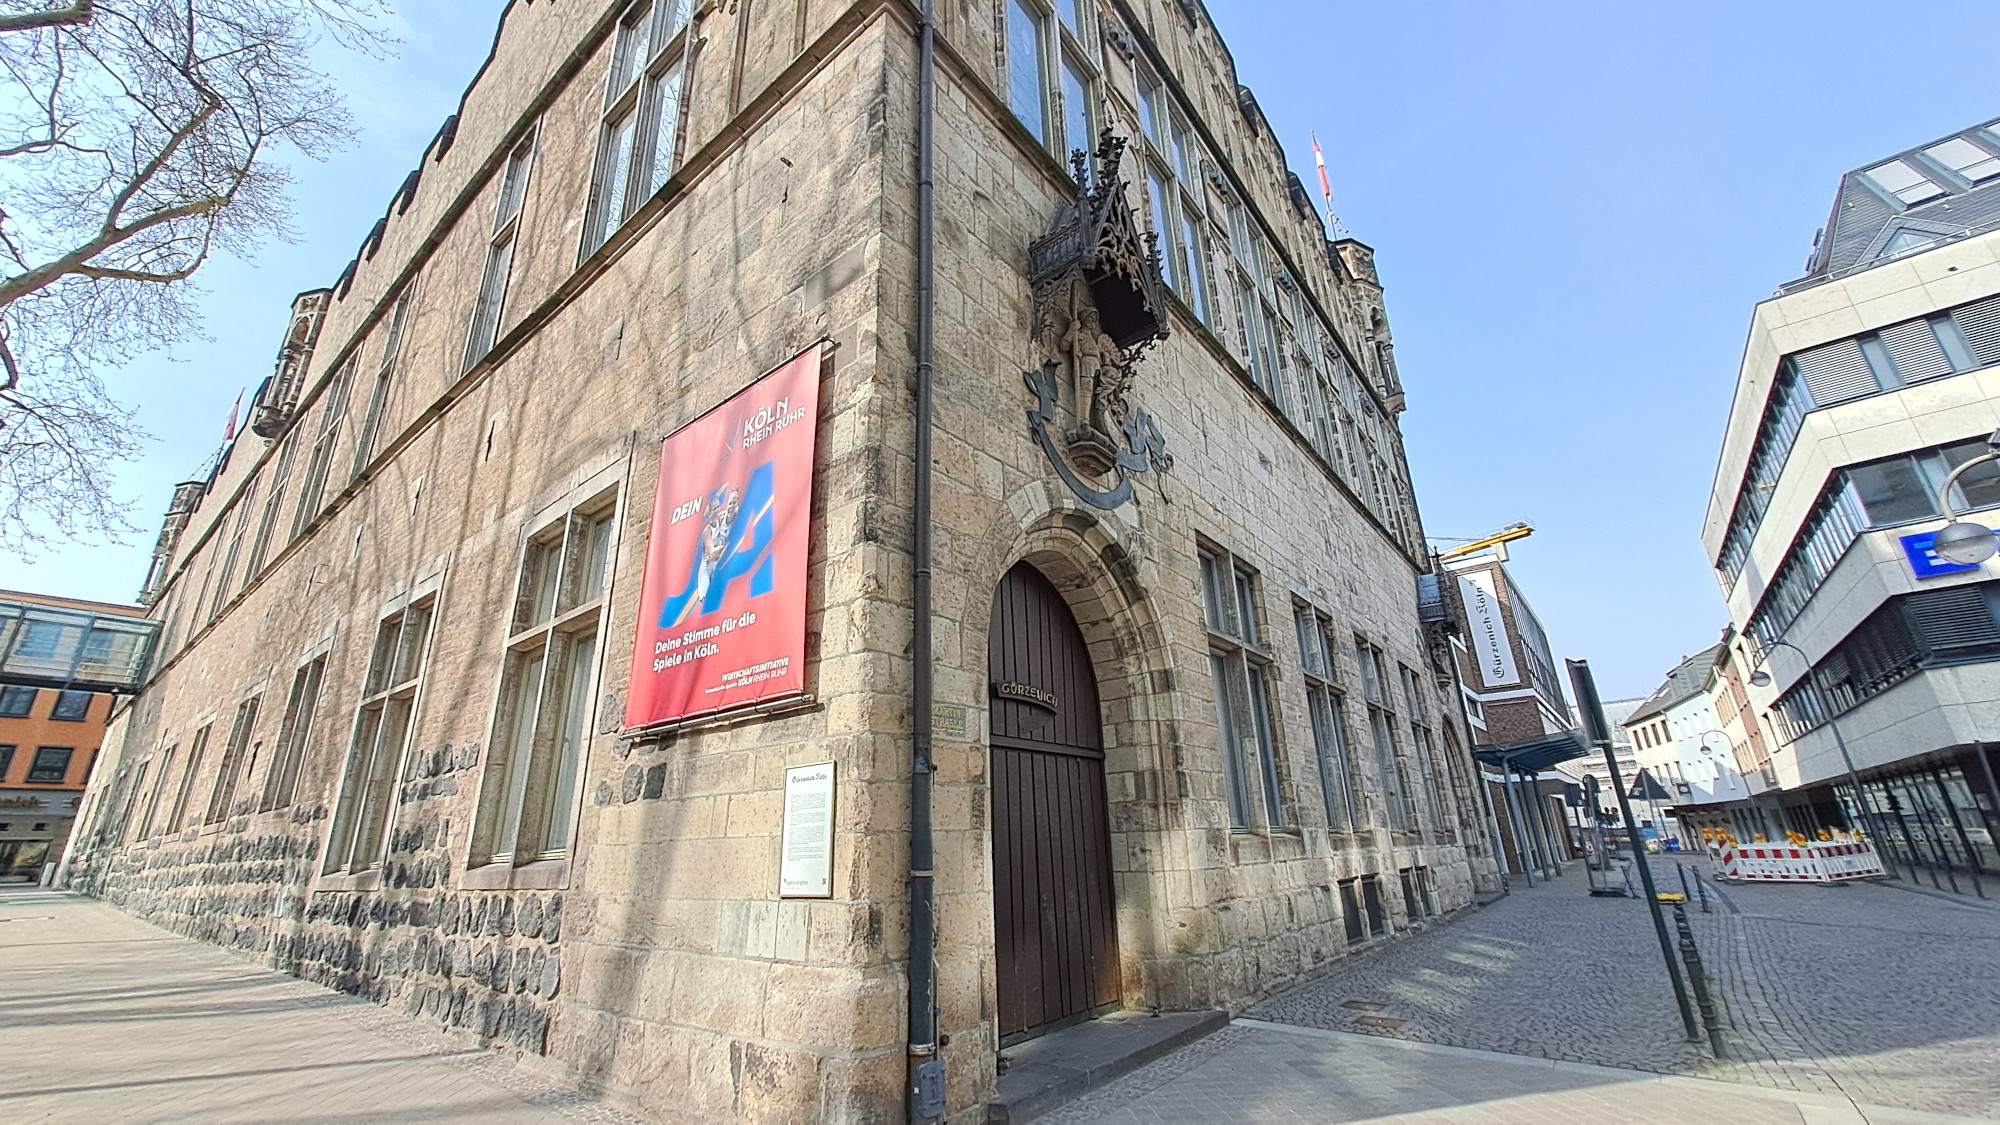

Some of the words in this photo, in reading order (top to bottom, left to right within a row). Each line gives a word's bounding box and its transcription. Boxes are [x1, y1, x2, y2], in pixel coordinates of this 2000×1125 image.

[742, 425, 773, 450] RHEIN
[775, 406, 806, 432] RUHR
[743, 396, 789, 437] KÖLN
[671, 495, 704, 525] DEIN
[1475, 586, 1488, 614] Köln
[654, 637, 681, 655] Deine
[682, 625, 720, 646] Stimme
[721, 617, 738, 634] für
[738, 611, 757, 628] die
[1483, 616, 1505, 679] Gürzenich
[652, 652, 681, 673] Spiele
[684, 648, 693, 662] in
[693, 642, 720, 660] Köln.
[721, 656, 790, 682] WIRTSCHAFTSINITIATIVE
[752, 670, 770, 684] RHEIN
[770, 666, 788, 679] RUHR
[1001, 680, 1059, 708] GÜRZENICH
